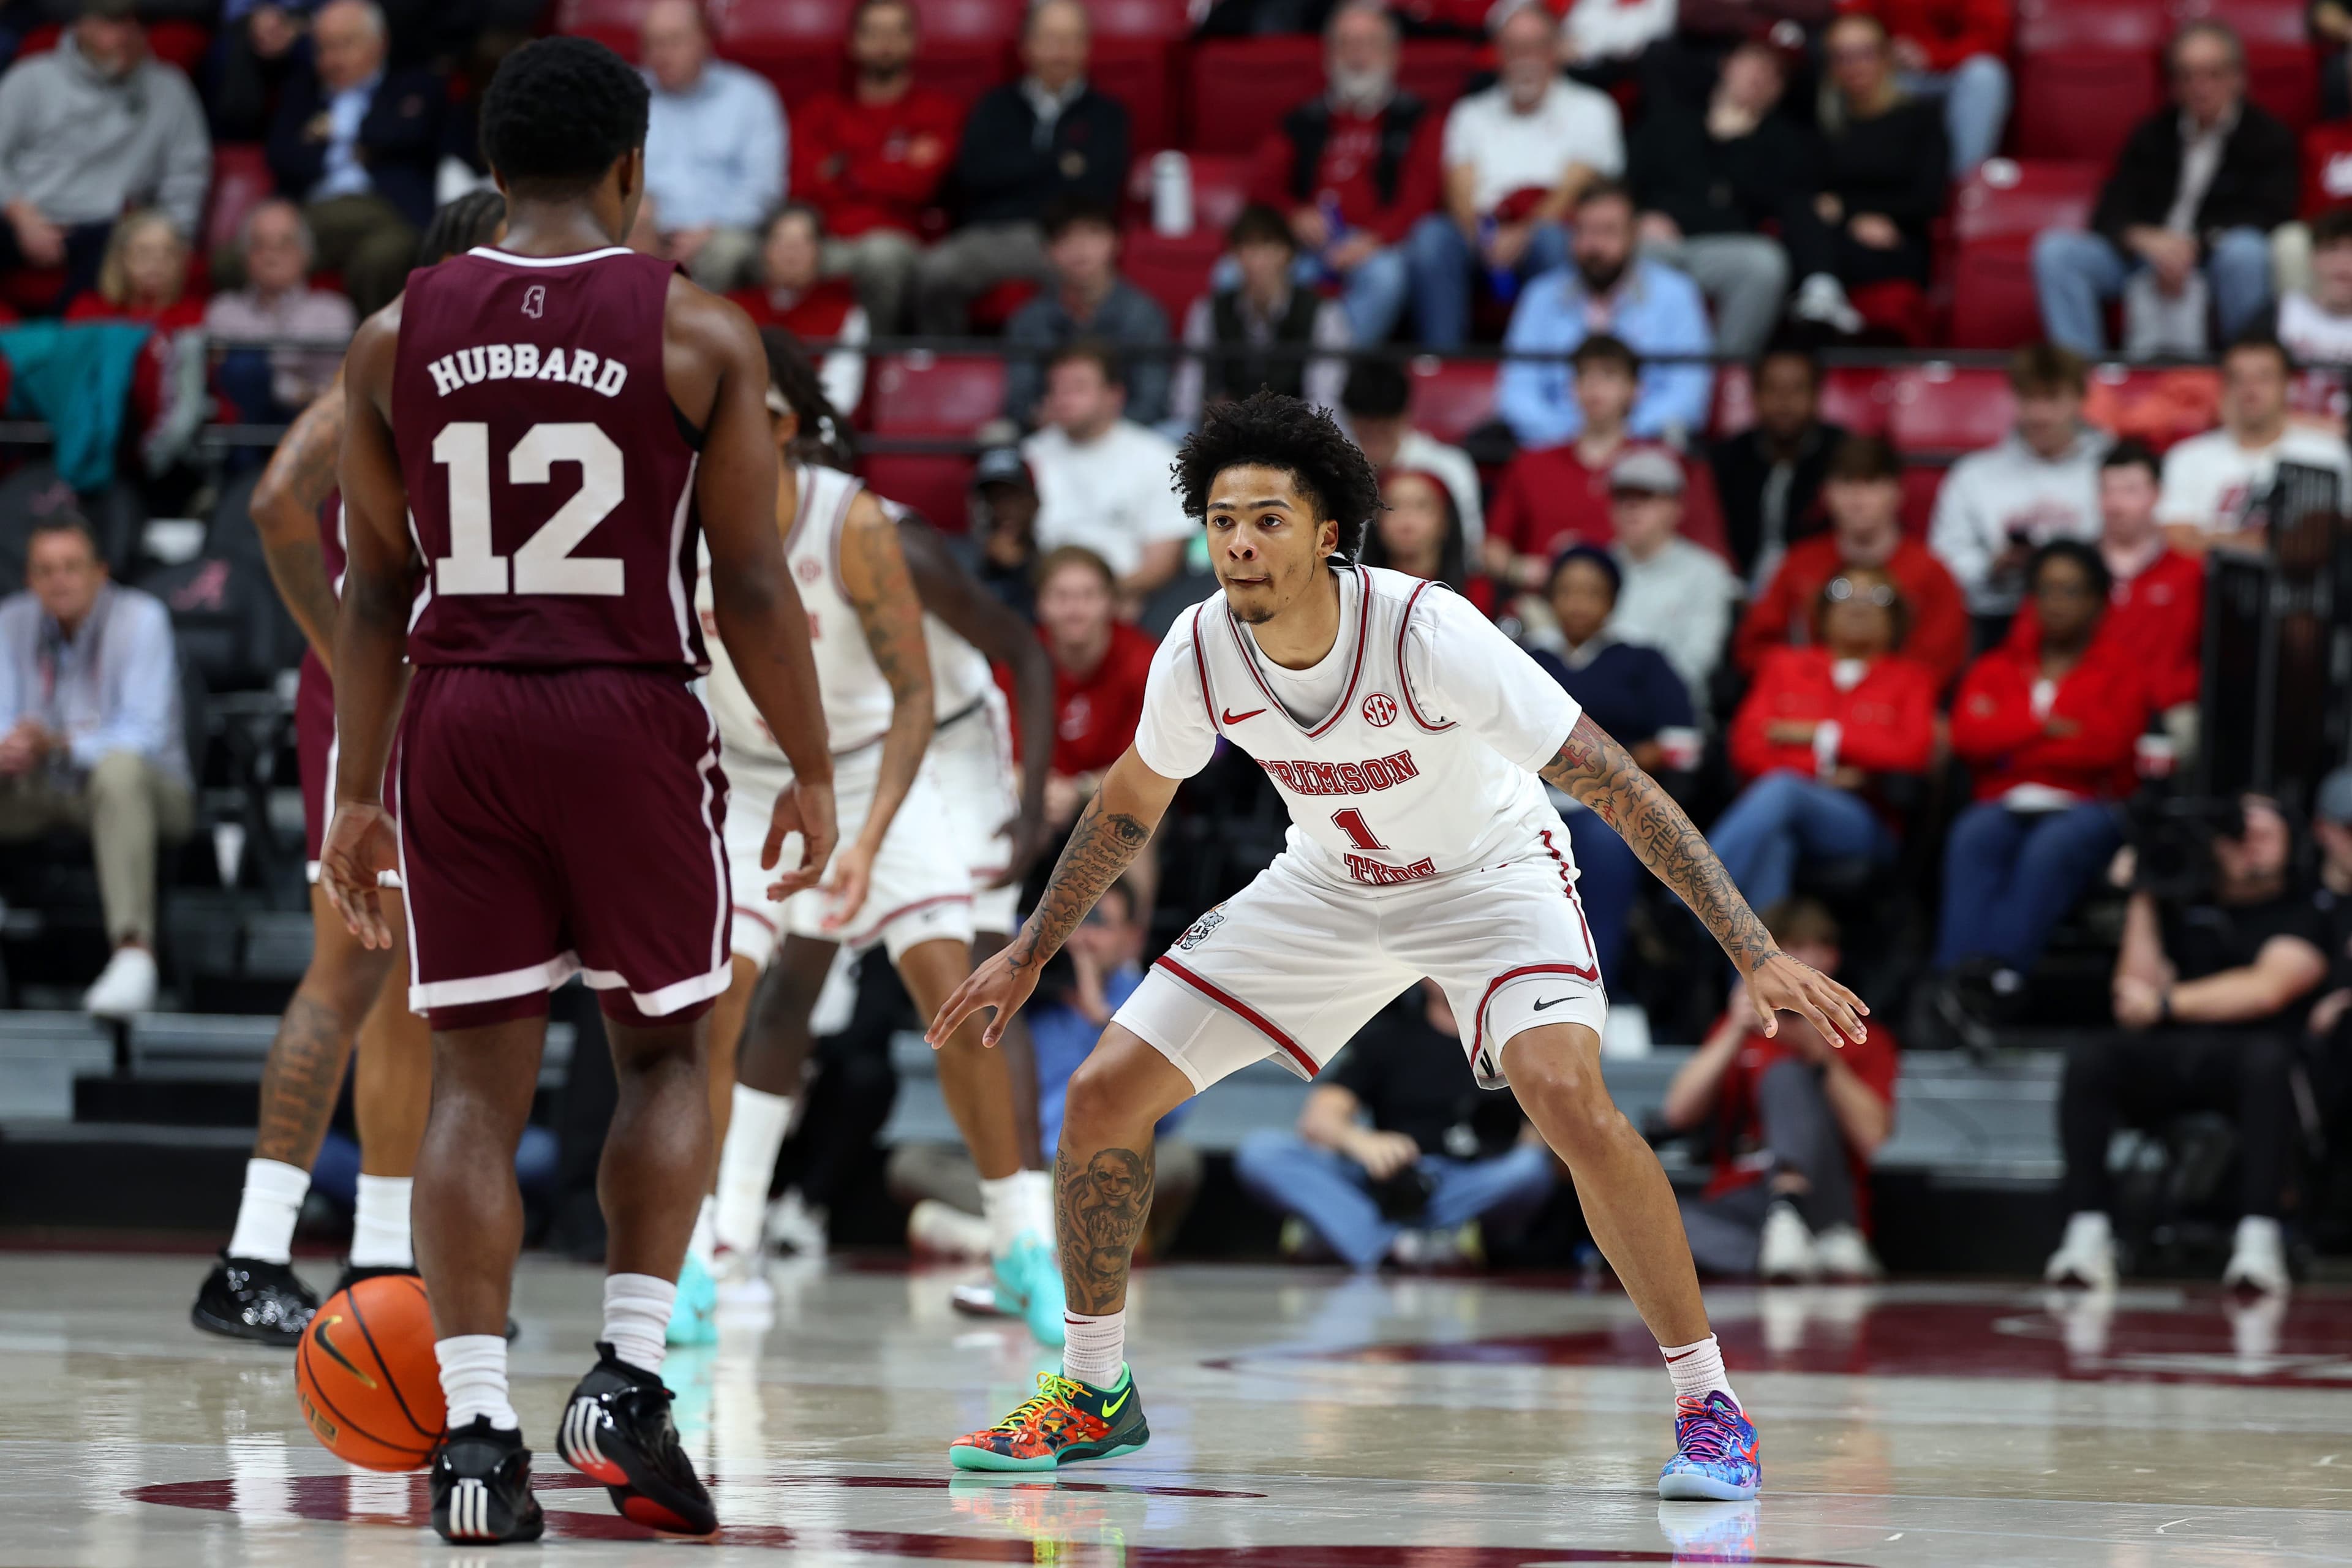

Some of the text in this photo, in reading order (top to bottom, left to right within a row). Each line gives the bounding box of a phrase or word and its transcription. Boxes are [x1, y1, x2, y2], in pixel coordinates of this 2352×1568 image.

[428, 344, 628, 397] HUBBARD
[432, 422, 625, 596] 12
[1363, 696, 1396, 726] SEC
[1330, 807, 1391, 850] 1
